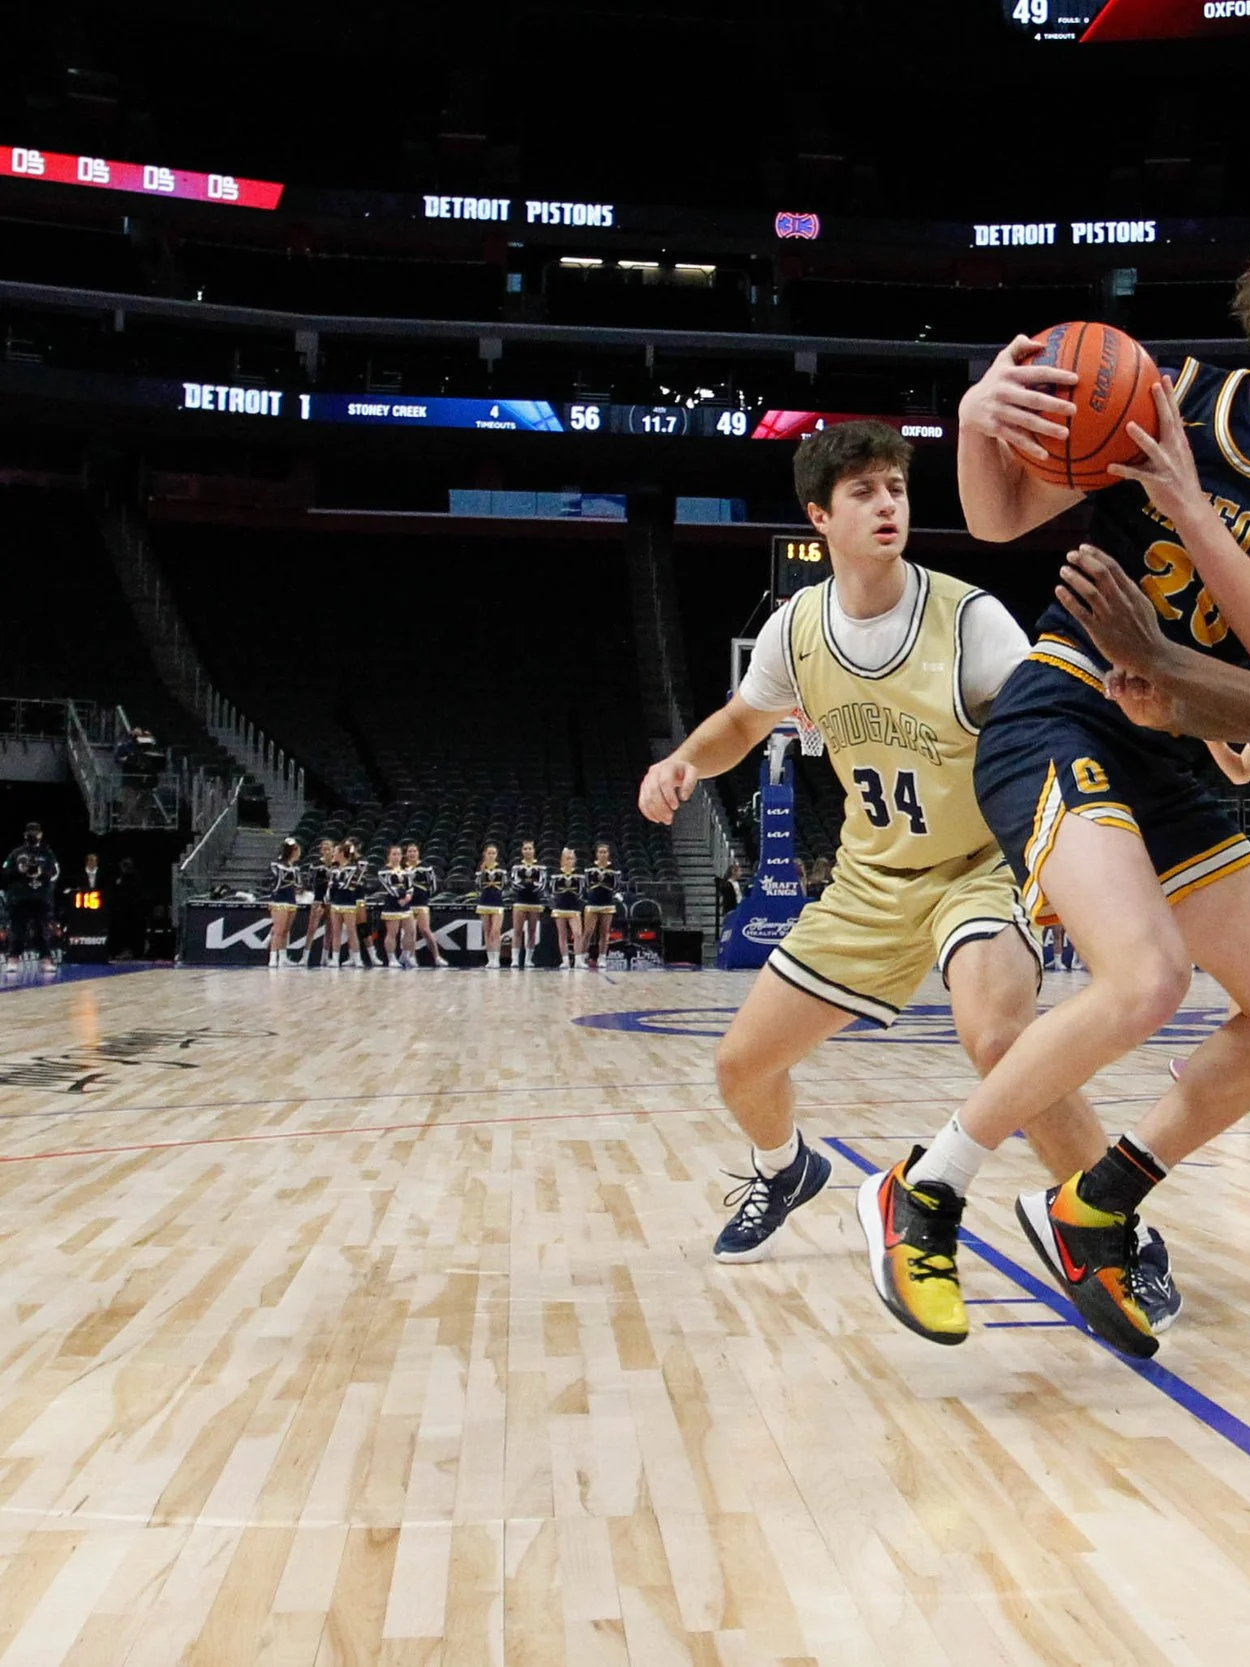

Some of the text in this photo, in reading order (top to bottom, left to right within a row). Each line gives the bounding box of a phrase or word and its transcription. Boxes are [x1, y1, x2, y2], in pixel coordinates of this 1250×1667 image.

[1012, 0, 1048, 25] 49
[422, 195, 614, 227] DETROIT PISTONS
[973, 220, 1156, 247] DETROIT PISTONS
[182, 382, 283, 417] DETROIT
[347, 403, 427, 418] STONEY CREEK
[489, 405, 499, 419] 4
[570, 405, 600, 430] 56
[475, 420, 516, 430] TIMEOUTS
[641, 415, 677, 433] 11.7
[716, 411, 747, 436] 49
[815, 418, 825, 432] 4
[901, 426, 943, 438] OXFORD
[787, 542, 822, 562] 11.6
[818, 702, 943, 767] COUGARS
[852, 765, 929, 835] 34
[764, 881, 799, 889] DRAFT
[766, 888, 798, 897] KINGS
